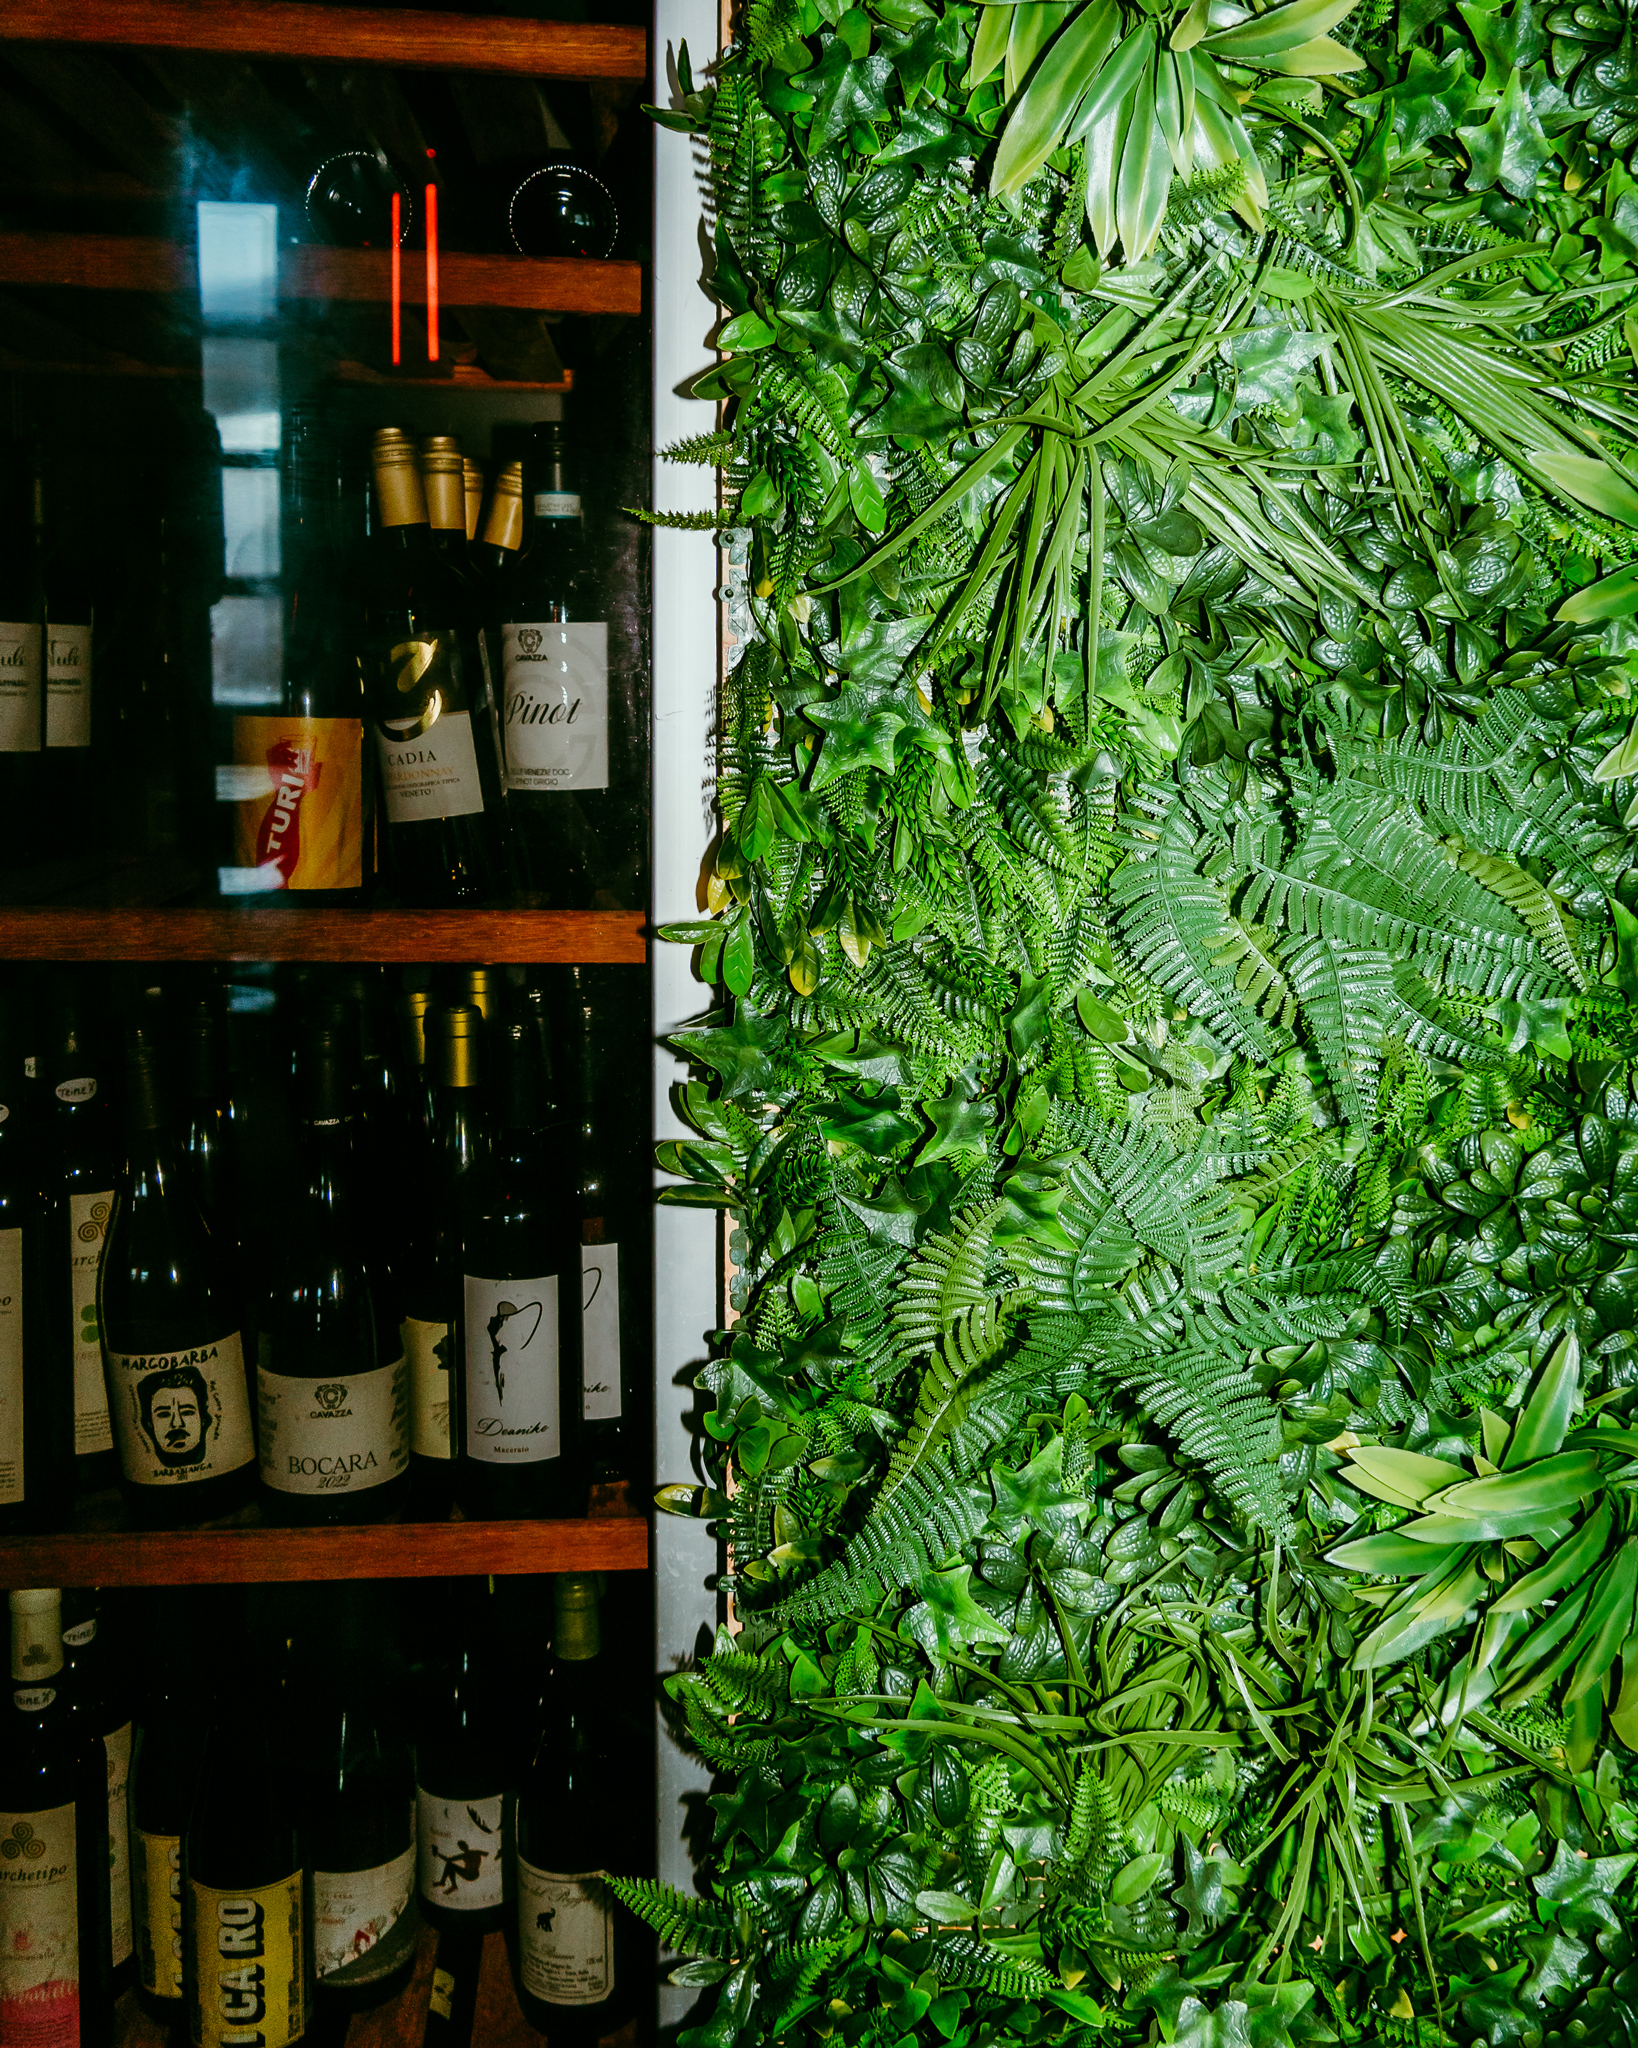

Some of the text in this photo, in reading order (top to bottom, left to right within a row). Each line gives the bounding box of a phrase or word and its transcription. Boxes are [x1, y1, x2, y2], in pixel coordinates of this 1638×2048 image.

[515, 654, 548, 662] CAVAZZA
[506, 690, 582, 725] Pinot
[552, 768, 570, 776] DOC
[400, 788, 432, 798] VENETO
[313, 1118, 341, 1126] CAVAZZA
[310, 1408, 353, 1419] CAVAZZA
[475, 1417, 550, 1437] Deanike
[288, 1450, 379, 1476] BOCARA
[316, 1475, 351, 1489] 2022
